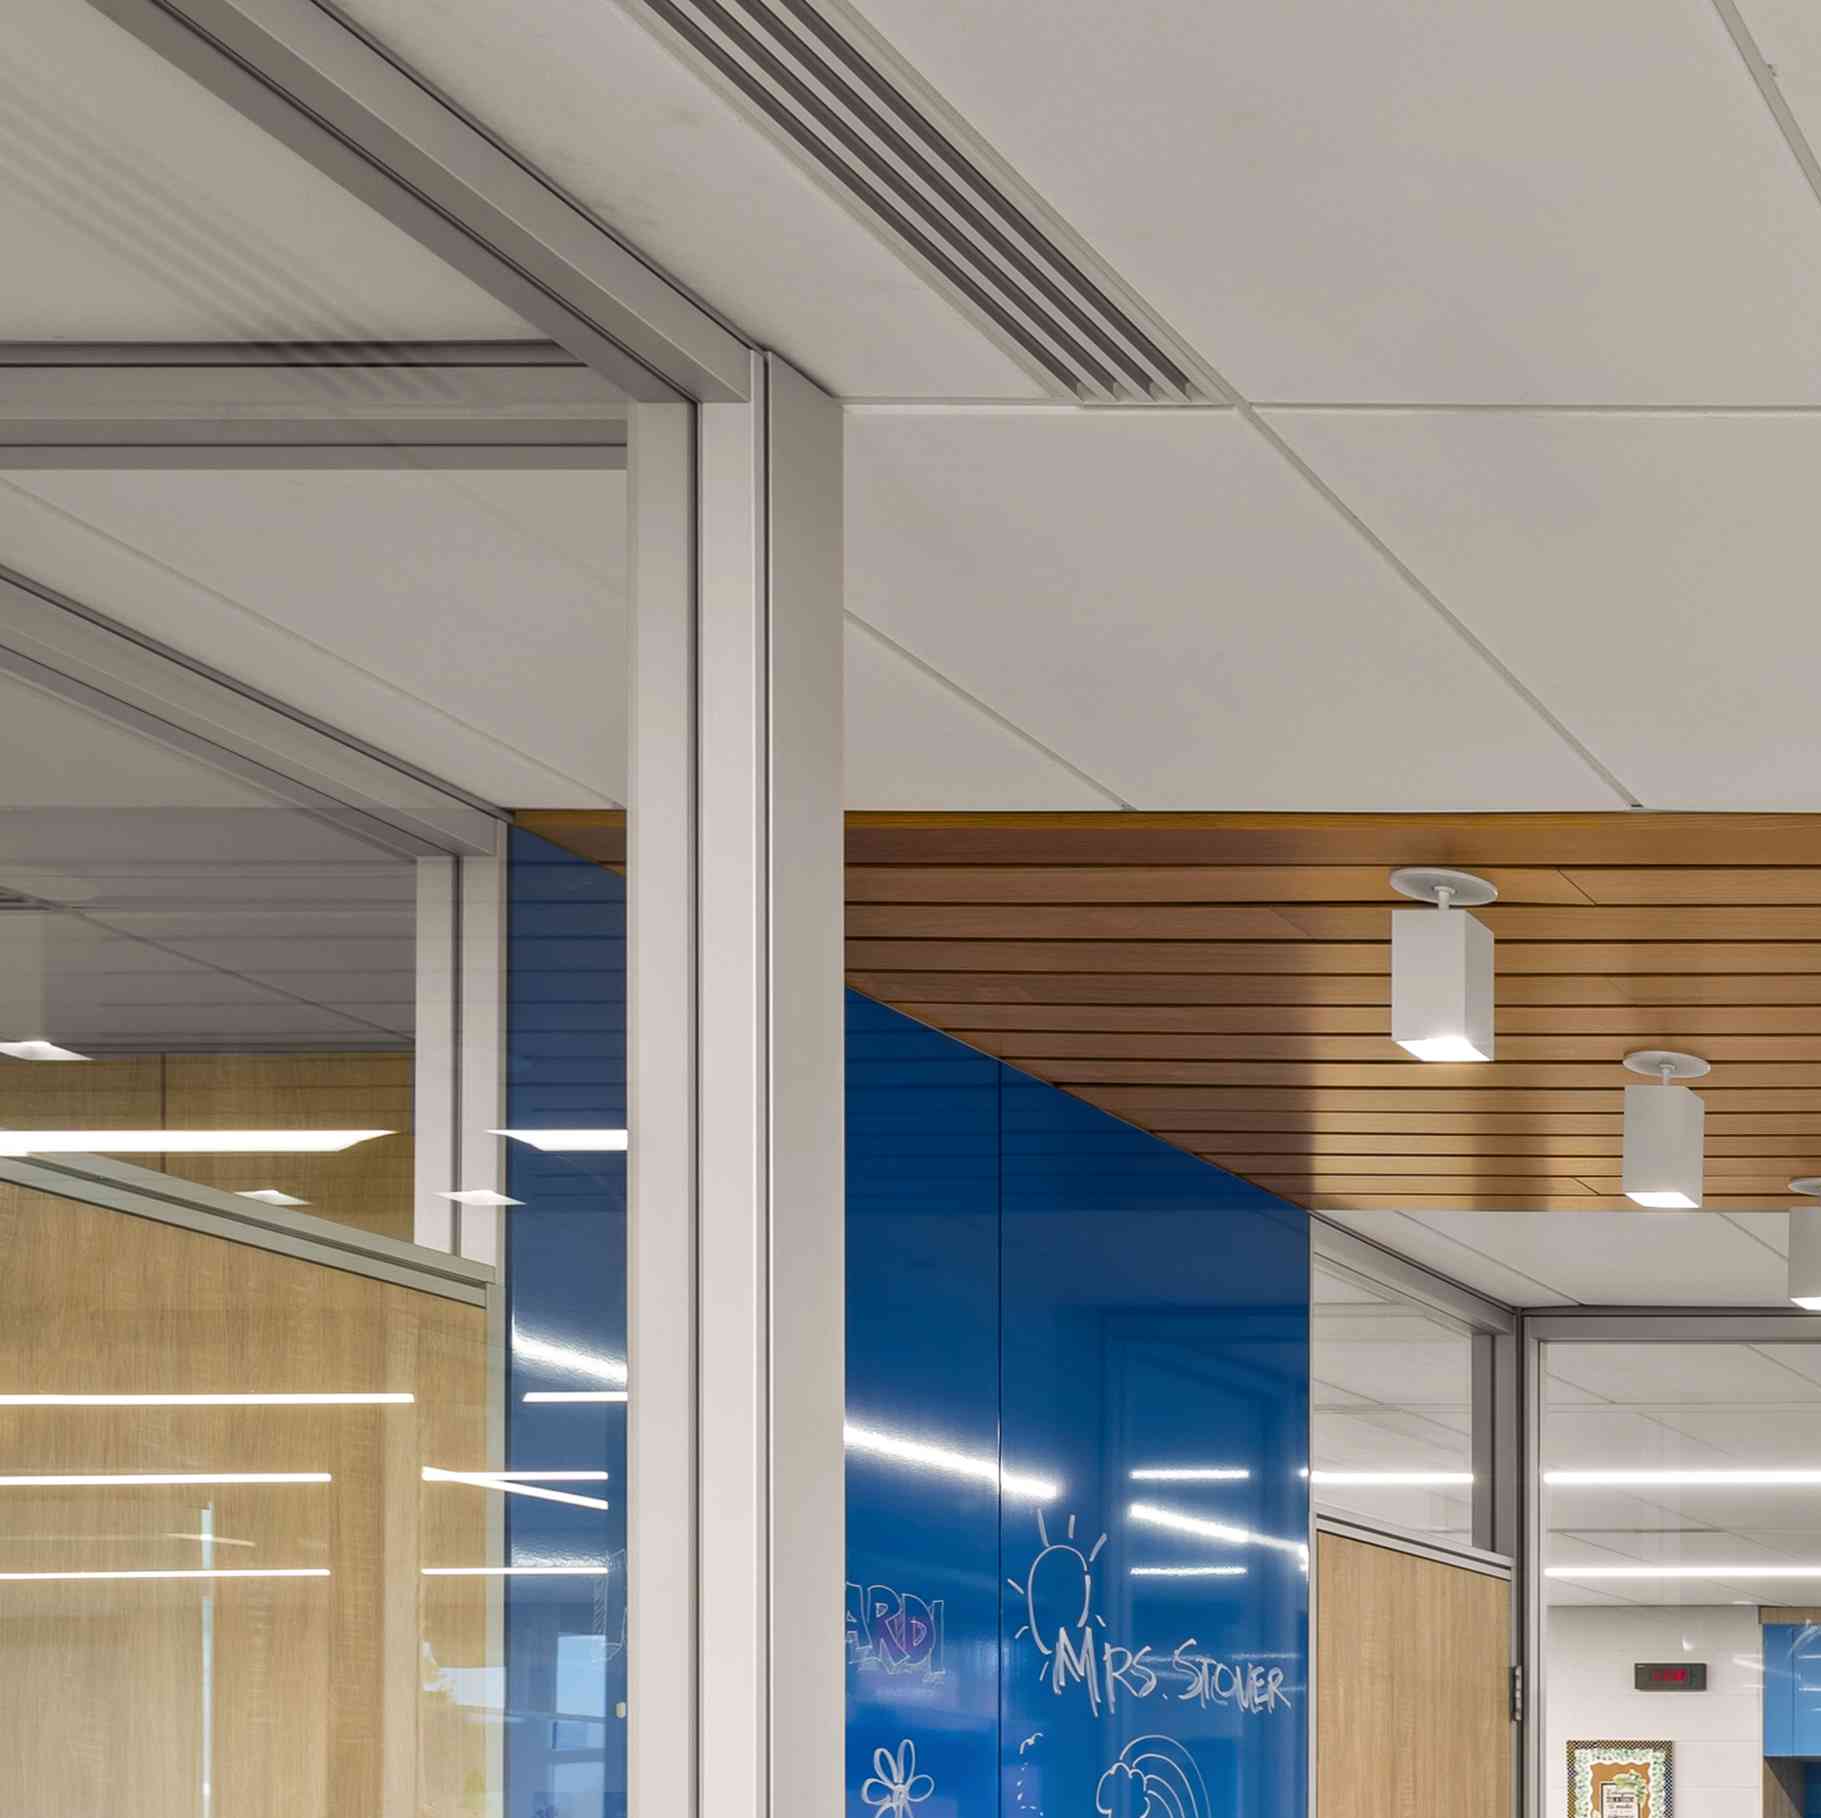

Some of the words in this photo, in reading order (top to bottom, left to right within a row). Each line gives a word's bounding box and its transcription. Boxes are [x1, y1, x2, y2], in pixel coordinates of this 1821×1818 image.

[846, 1582, 946, 1676] ARDI
[1053, 1626, 1169, 1718] MRS.
[1172, 1638, 1293, 1714] STOVER
